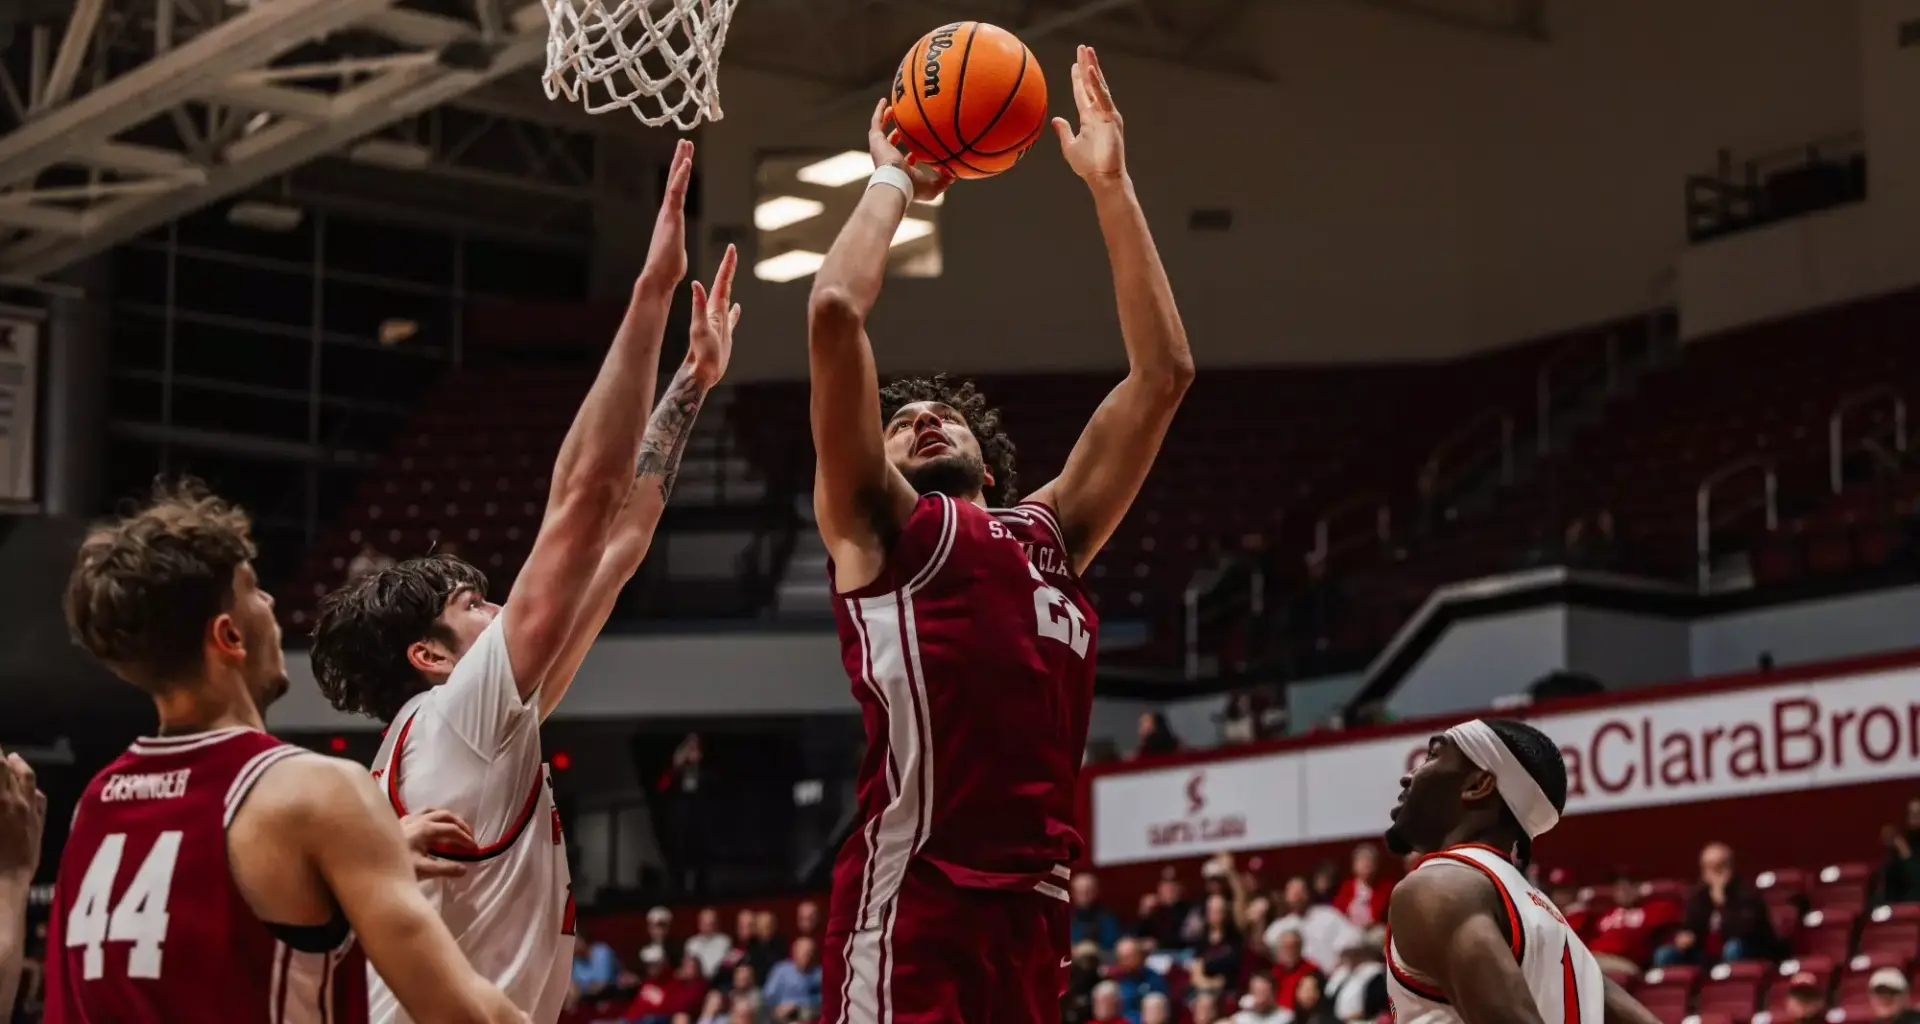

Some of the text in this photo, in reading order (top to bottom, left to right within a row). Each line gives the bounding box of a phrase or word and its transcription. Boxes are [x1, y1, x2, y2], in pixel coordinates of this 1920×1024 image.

[1031, 568, 1091, 660] 22
[1559, 696, 1920, 798] aClaraBro
[66, 831, 184, 981] 44
